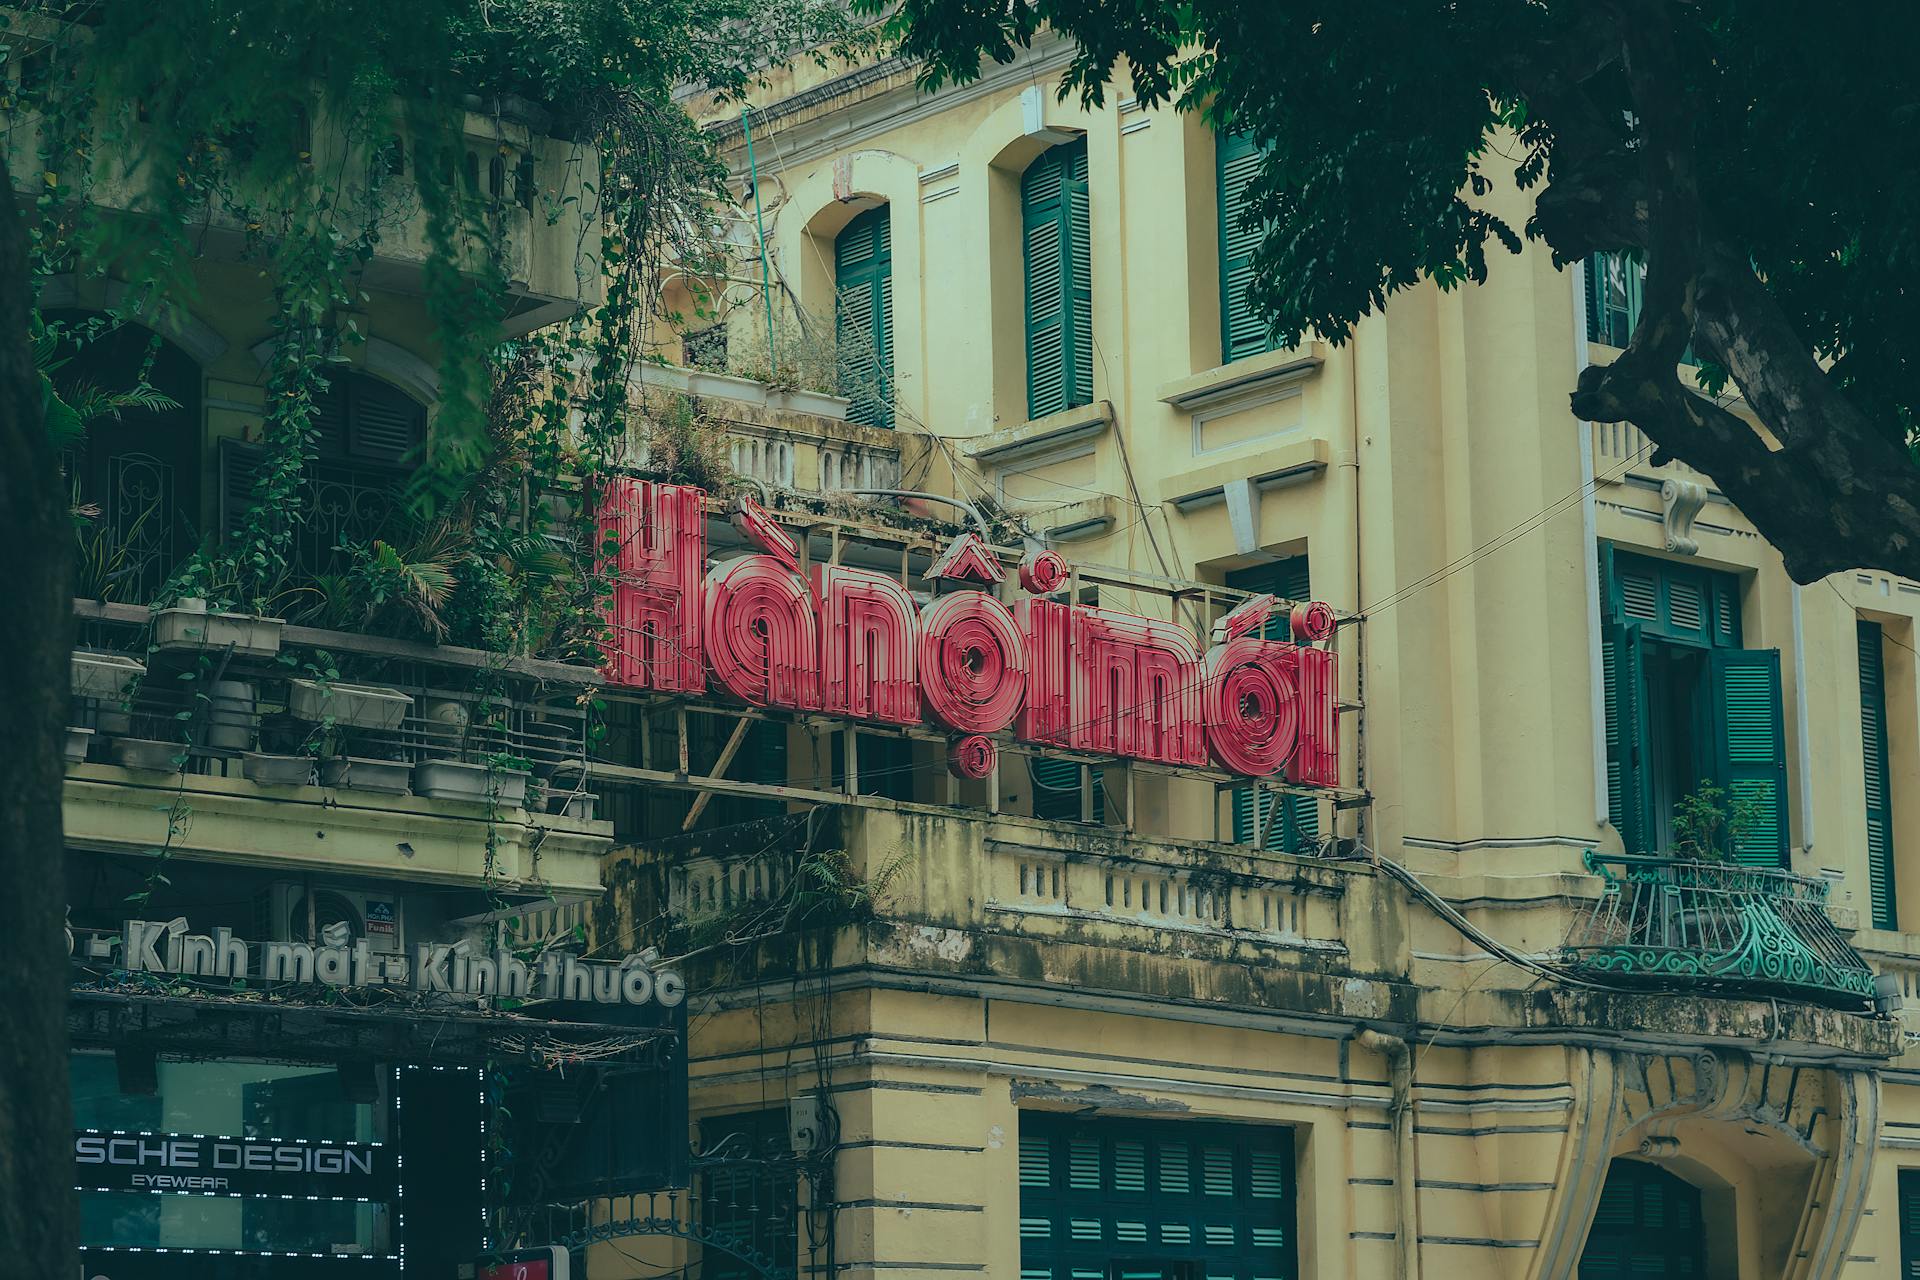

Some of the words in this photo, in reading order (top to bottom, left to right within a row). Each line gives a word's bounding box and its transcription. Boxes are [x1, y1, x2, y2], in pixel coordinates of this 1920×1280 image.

[124, 917, 249, 978] Kính
[264, 921, 369, 986] mắt
[415, 939, 530, 998] Kính
[542, 946, 687, 1008] thuốc
[213, 1143, 373, 1175] DESIGN
[131, 1173, 229, 1189] EYEWEAR
